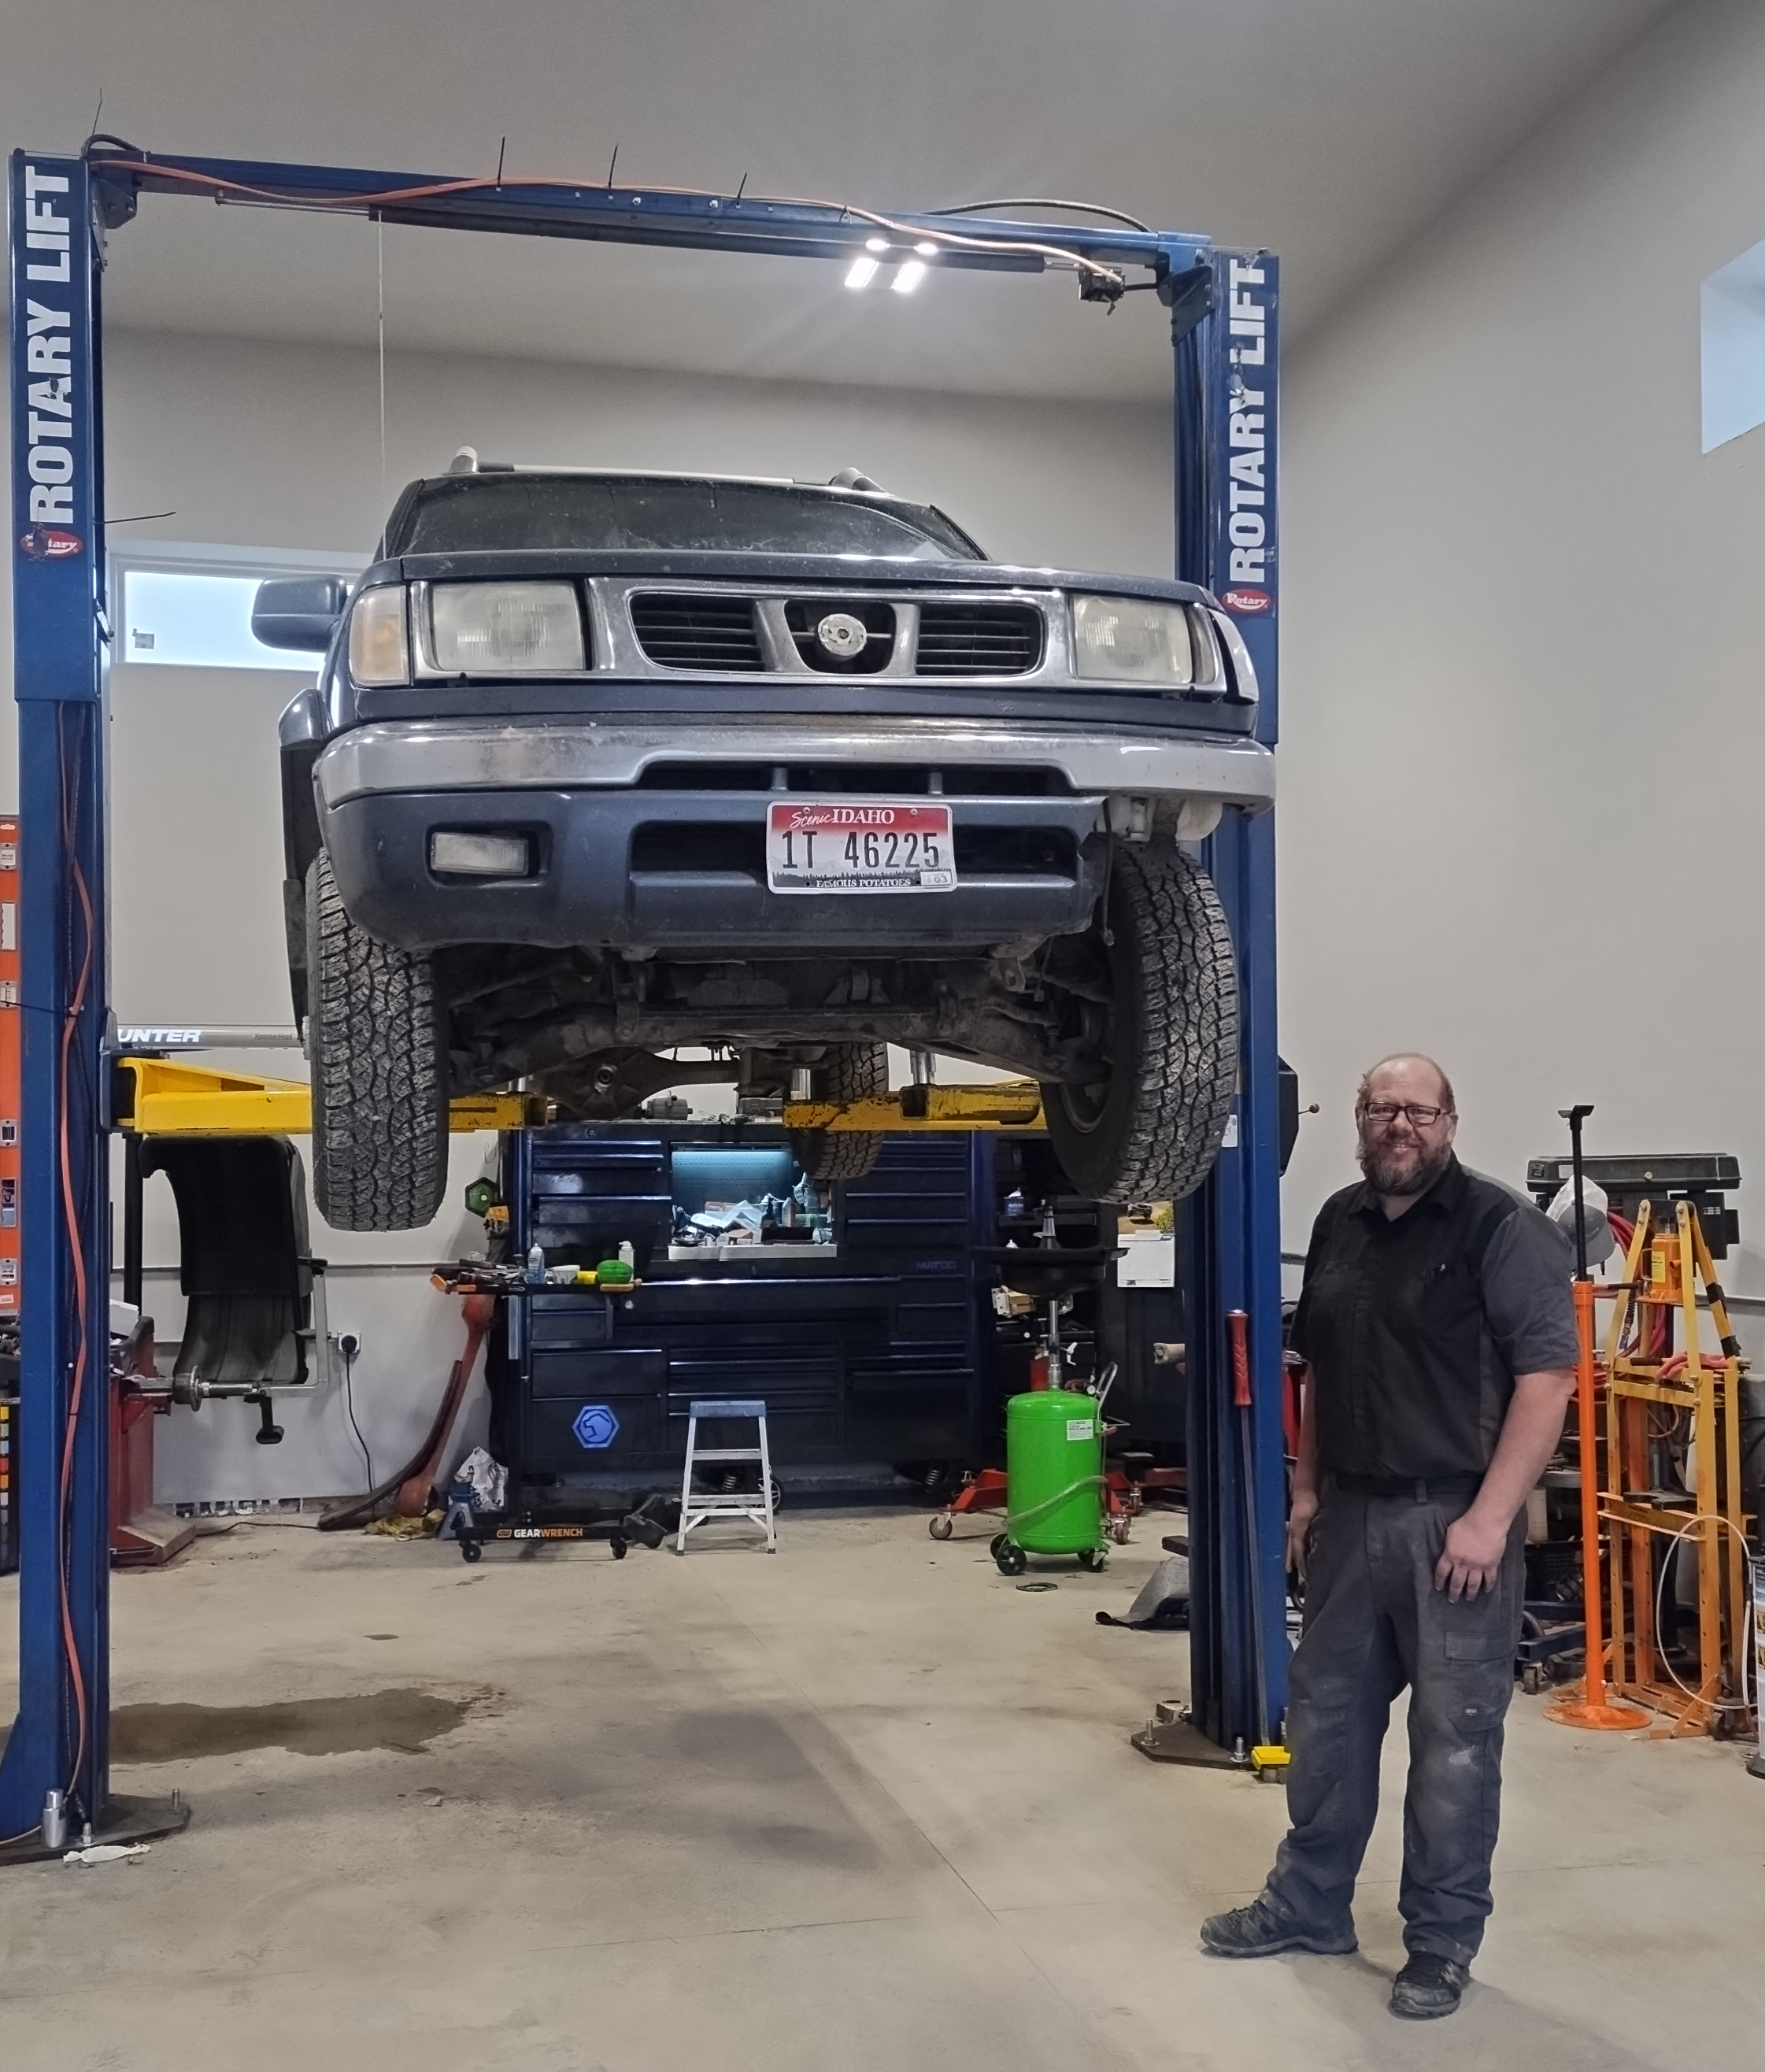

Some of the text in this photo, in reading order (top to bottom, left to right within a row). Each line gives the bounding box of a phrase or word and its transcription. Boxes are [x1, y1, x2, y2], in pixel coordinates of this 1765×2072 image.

[25, 165, 74, 524] ROTARY LIFT
[1229, 258, 1266, 583] ROTARY LIFT
[25, 535, 78, 554] tary
[1226, 592, 1268, 609] Rotary
[790, 808, 895, 829] Scenic IDAHO
[782, 830, 940, 869] 1T 46225
[816, 879, 912, 888] FAMOUS POTATOES
[117, 1028, 202, 1042] UNTER
[916, 1260, 957, 1270] MATCO
[514, 1528, 583, 1538] GEARWRENCH
